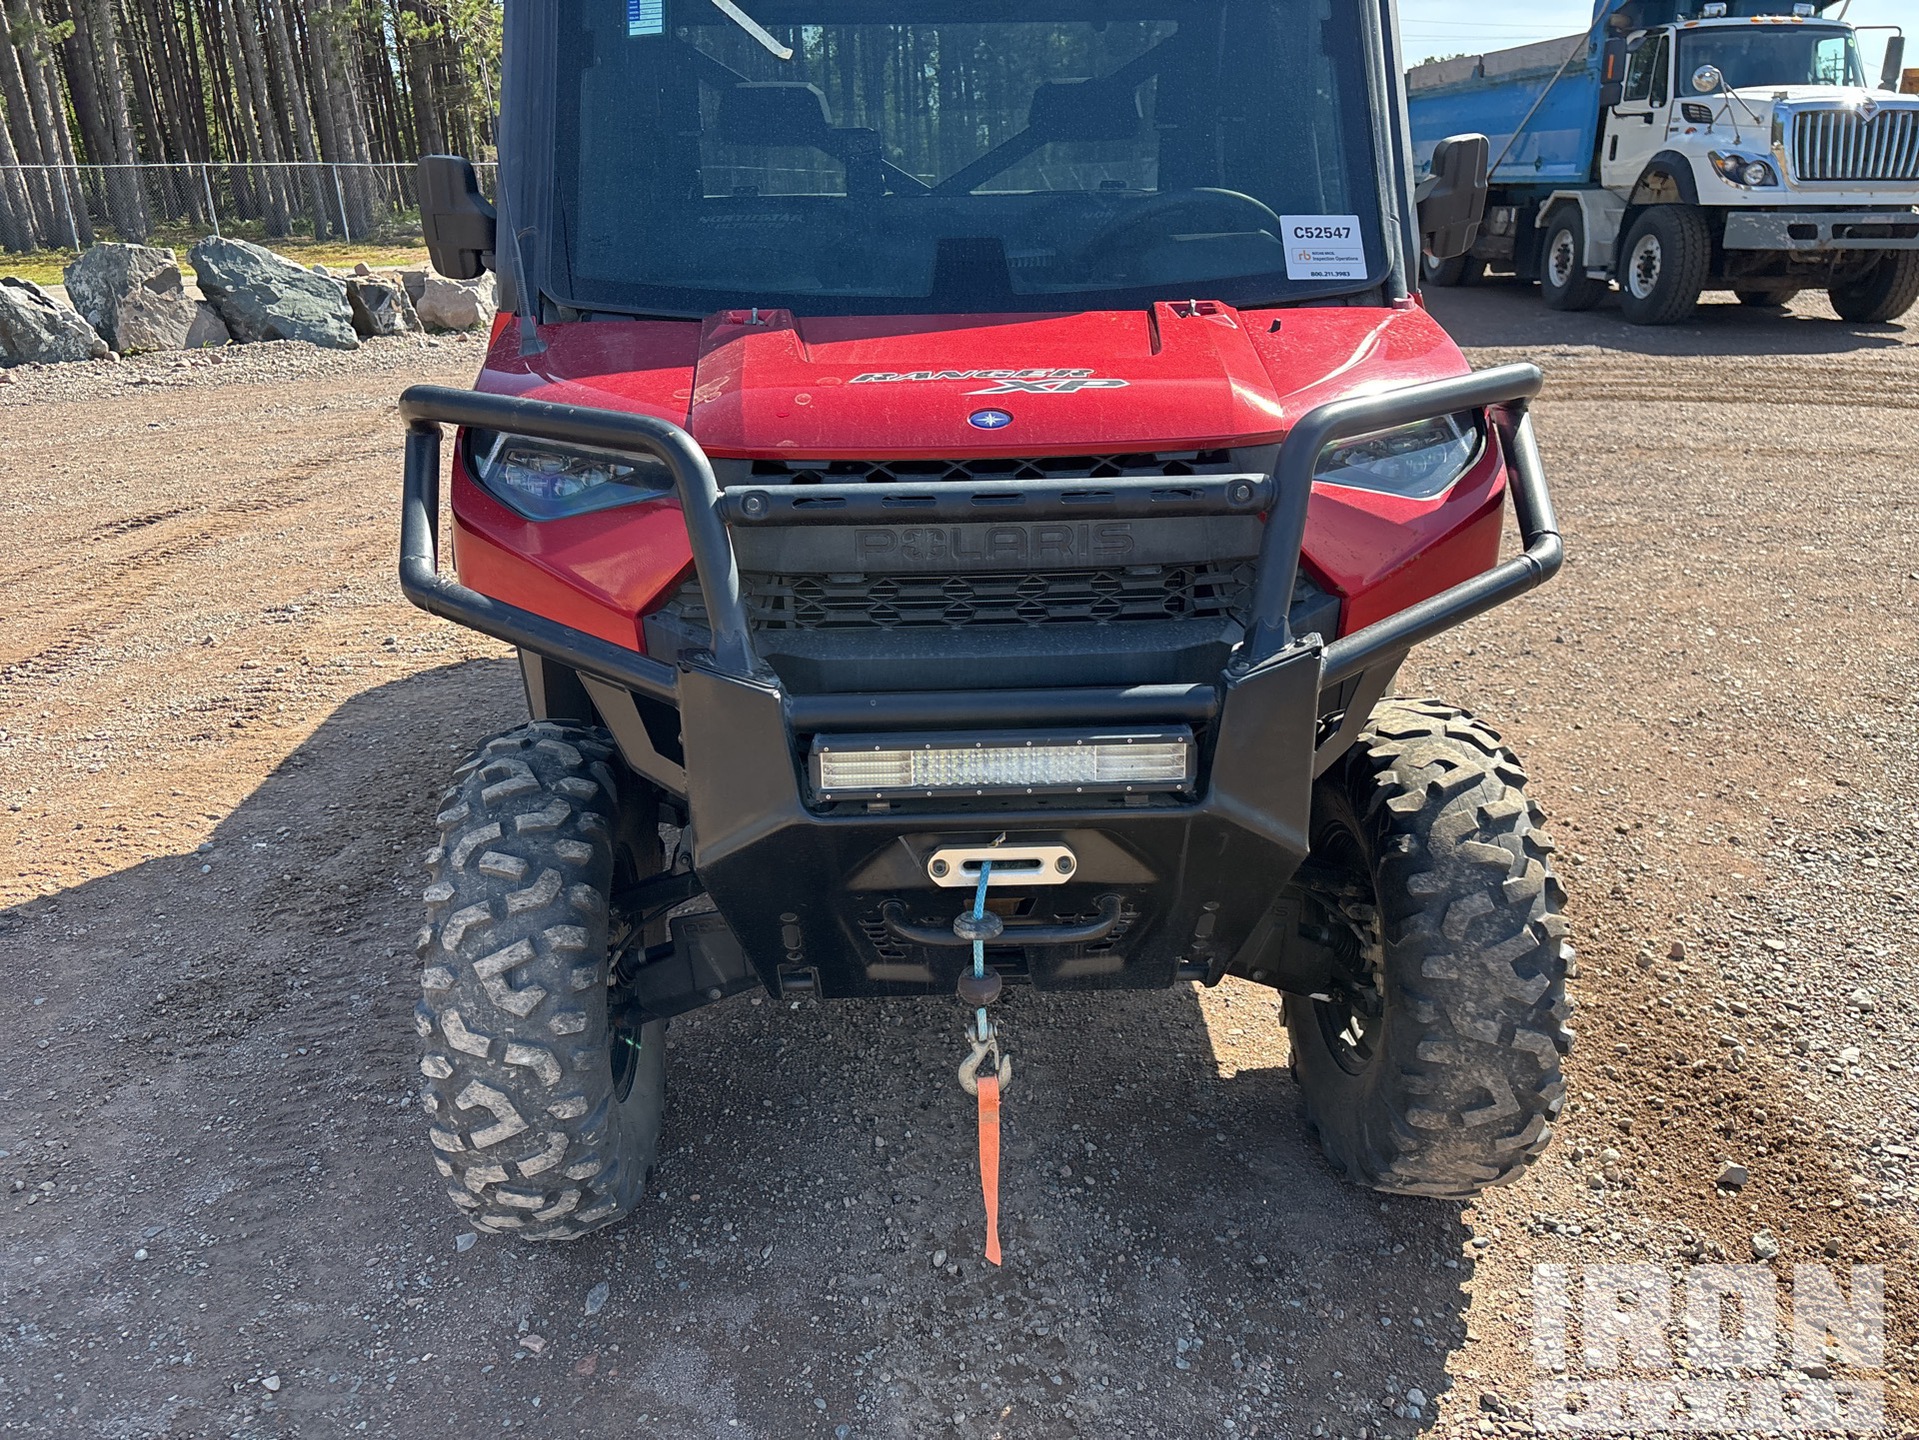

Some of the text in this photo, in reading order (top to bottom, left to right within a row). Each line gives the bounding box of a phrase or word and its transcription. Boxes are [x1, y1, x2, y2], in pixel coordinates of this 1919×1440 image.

[1294, 227, 1350, 239] C52547
[849, 368, 1095, 383] RANGER
[958, 378, 1131, 396] XP
[854, 523, 1135, 562] POLARIS
